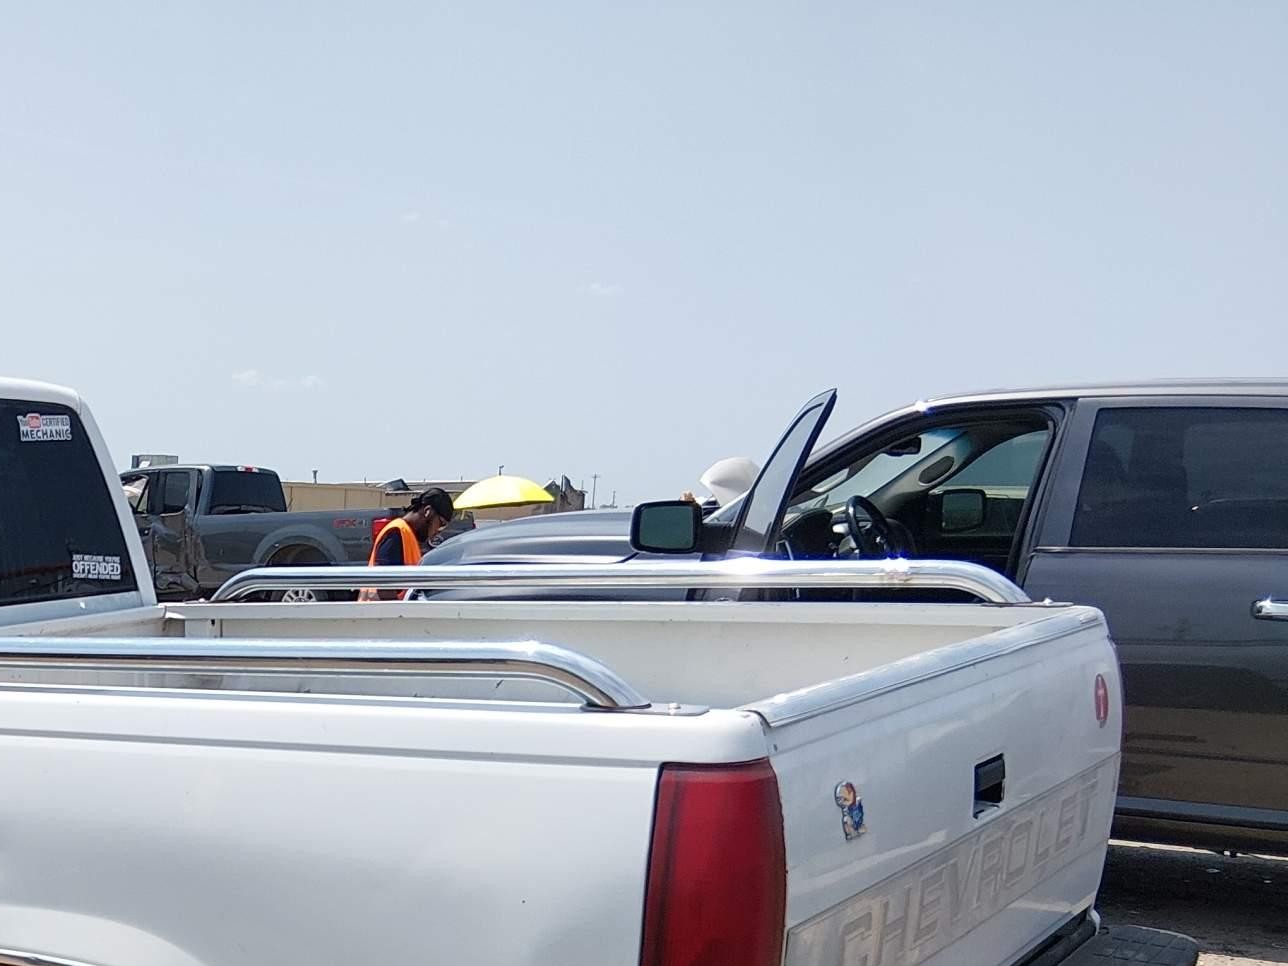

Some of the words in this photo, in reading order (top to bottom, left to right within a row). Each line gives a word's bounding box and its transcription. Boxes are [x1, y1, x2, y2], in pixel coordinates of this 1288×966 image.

[42, 417, 69, 426] CERTIFIED
[22, 429, 71, 439] MECHANIC
[73, 561, 121, 574] OFFENDED
